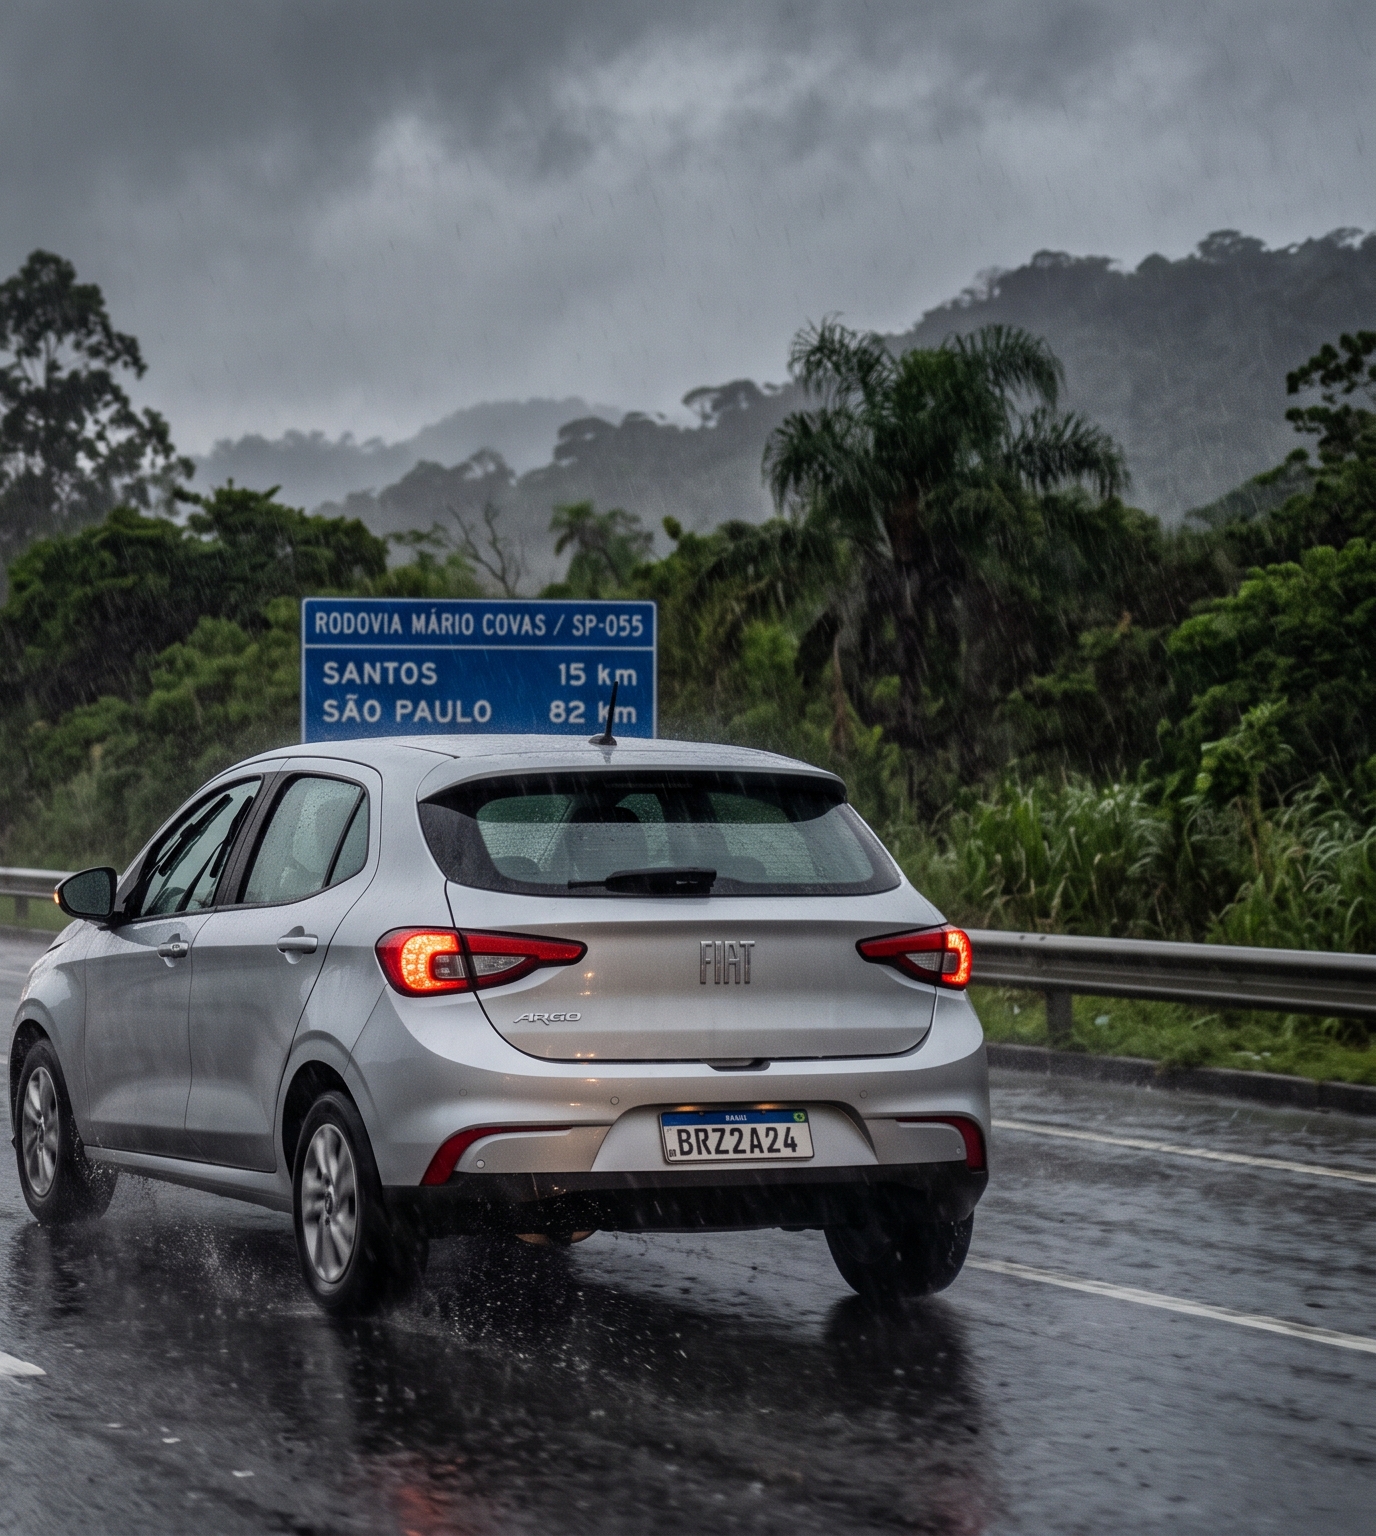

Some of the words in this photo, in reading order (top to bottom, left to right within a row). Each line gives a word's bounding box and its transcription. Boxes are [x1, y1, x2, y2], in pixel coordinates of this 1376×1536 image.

[315, 611, 402, 635] RODOVIA
[411, 607, 474, 635] MÁRIO
[482, 613, 546, 636] COVAS
[553, 613, 565, 636] /
[572, 614, 643, 637] SP-055
[323, 661, 438, 685] SANTOS
[559, 662, 586, 686] 15
[598, 663, 637, 686] km
[323, 693, 382, 723] SÃO
[395, 699, 492, 723] PAULO
[549, 700, 585, 724] 82
[598, 701, 637, 724] km
[699, 940, 755, 984] FIAT
[513, 1011, 582, 1025] ARGO
[677, 1126, 798, 1156] BRZ2A24
